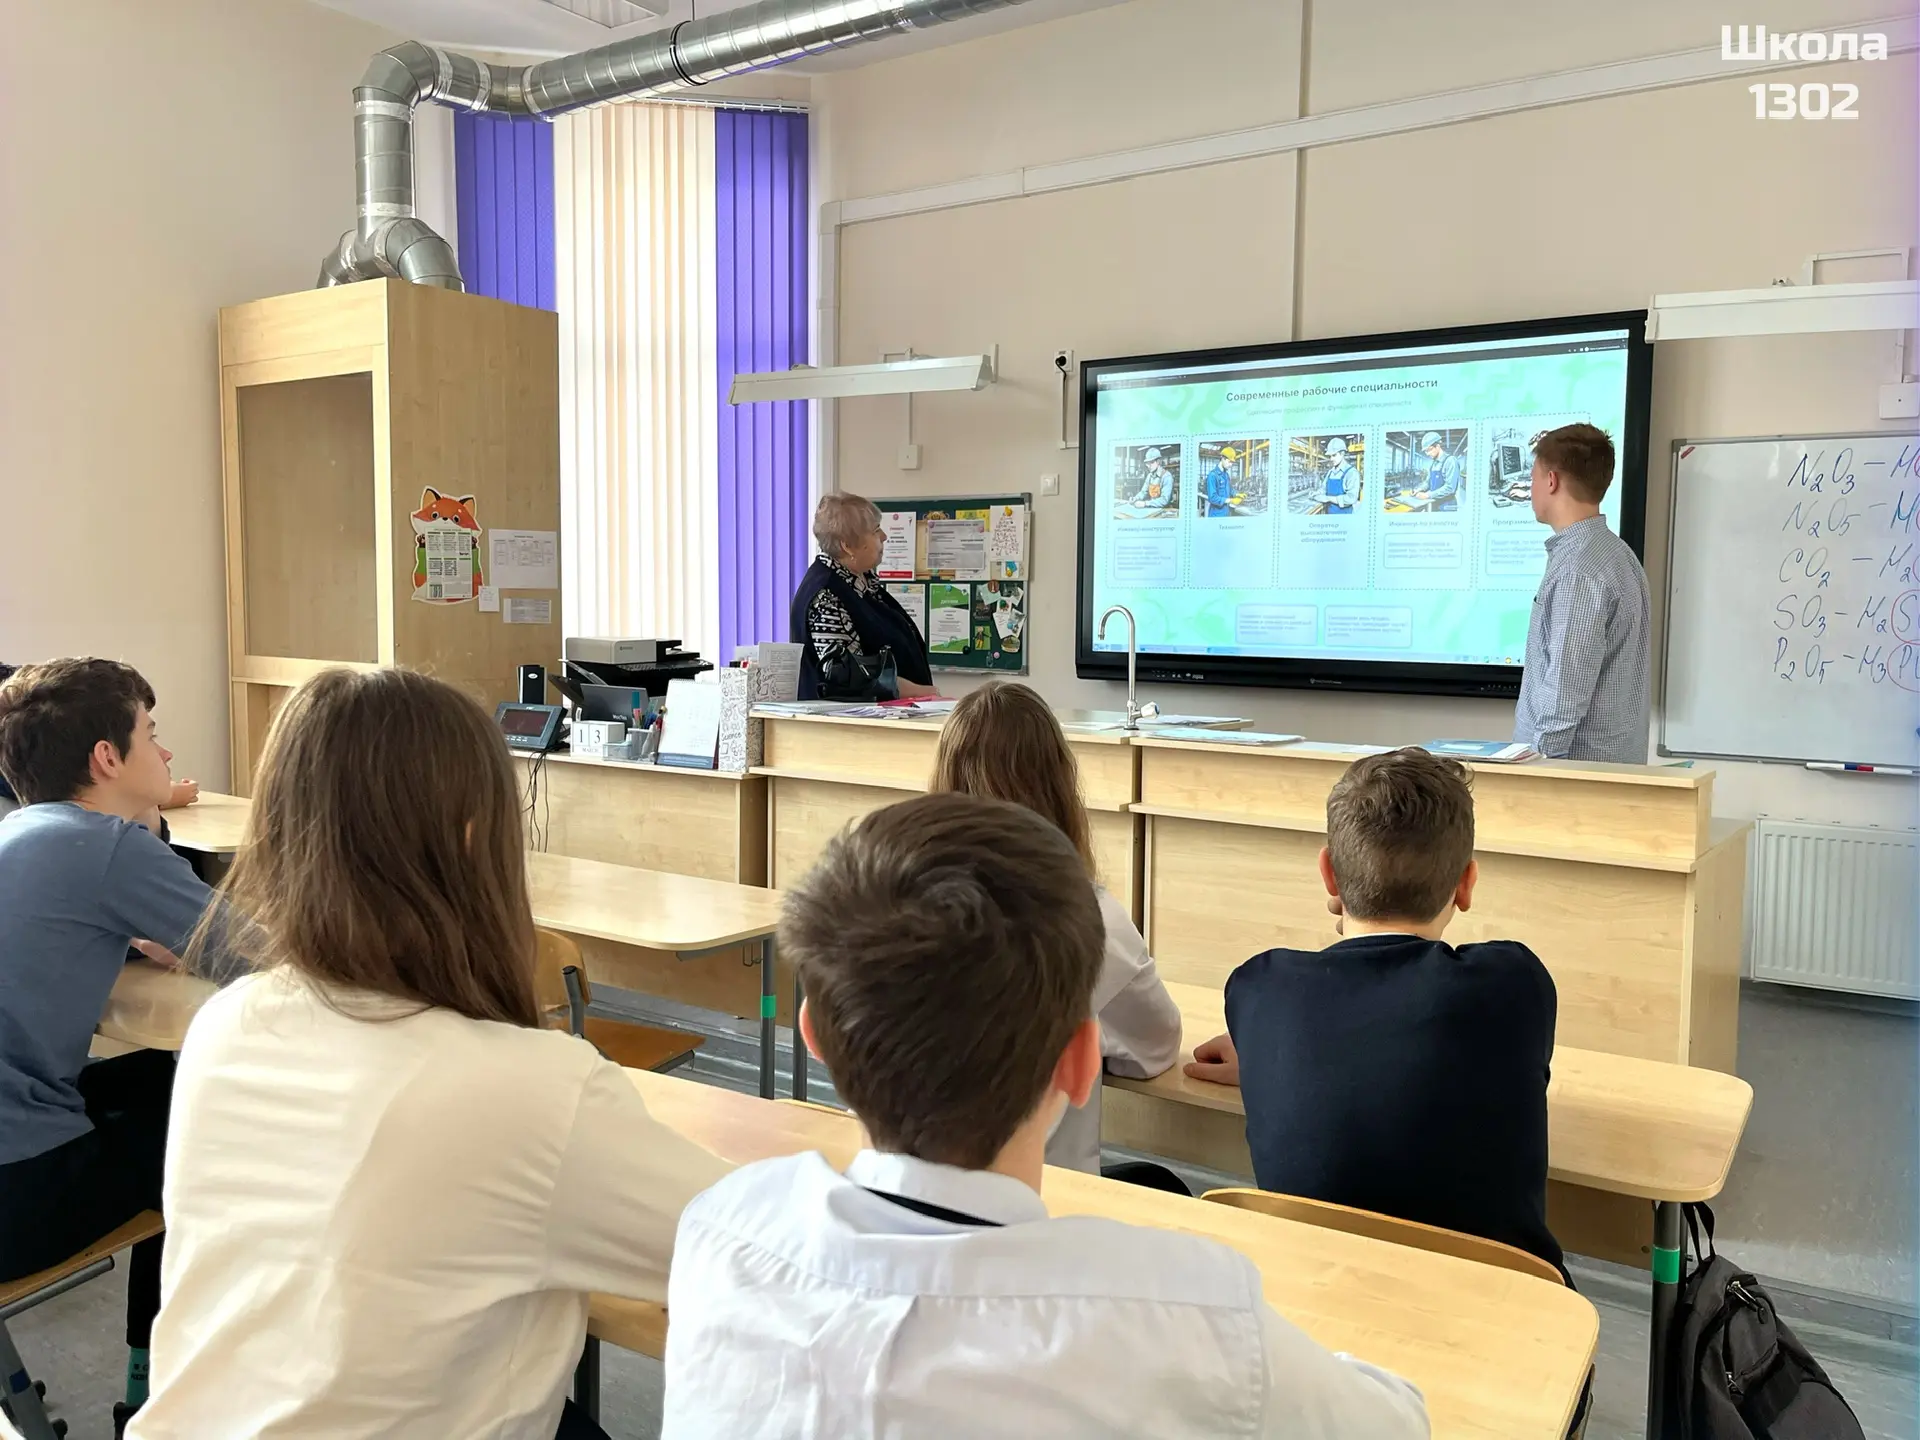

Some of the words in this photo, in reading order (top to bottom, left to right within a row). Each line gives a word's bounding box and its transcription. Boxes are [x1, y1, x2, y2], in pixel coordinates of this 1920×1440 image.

[1226, 389, 1299, 402] Современные
[1302, 384, 1348, 398] рабочие
[1350, 379, 1438, 393] специальности
